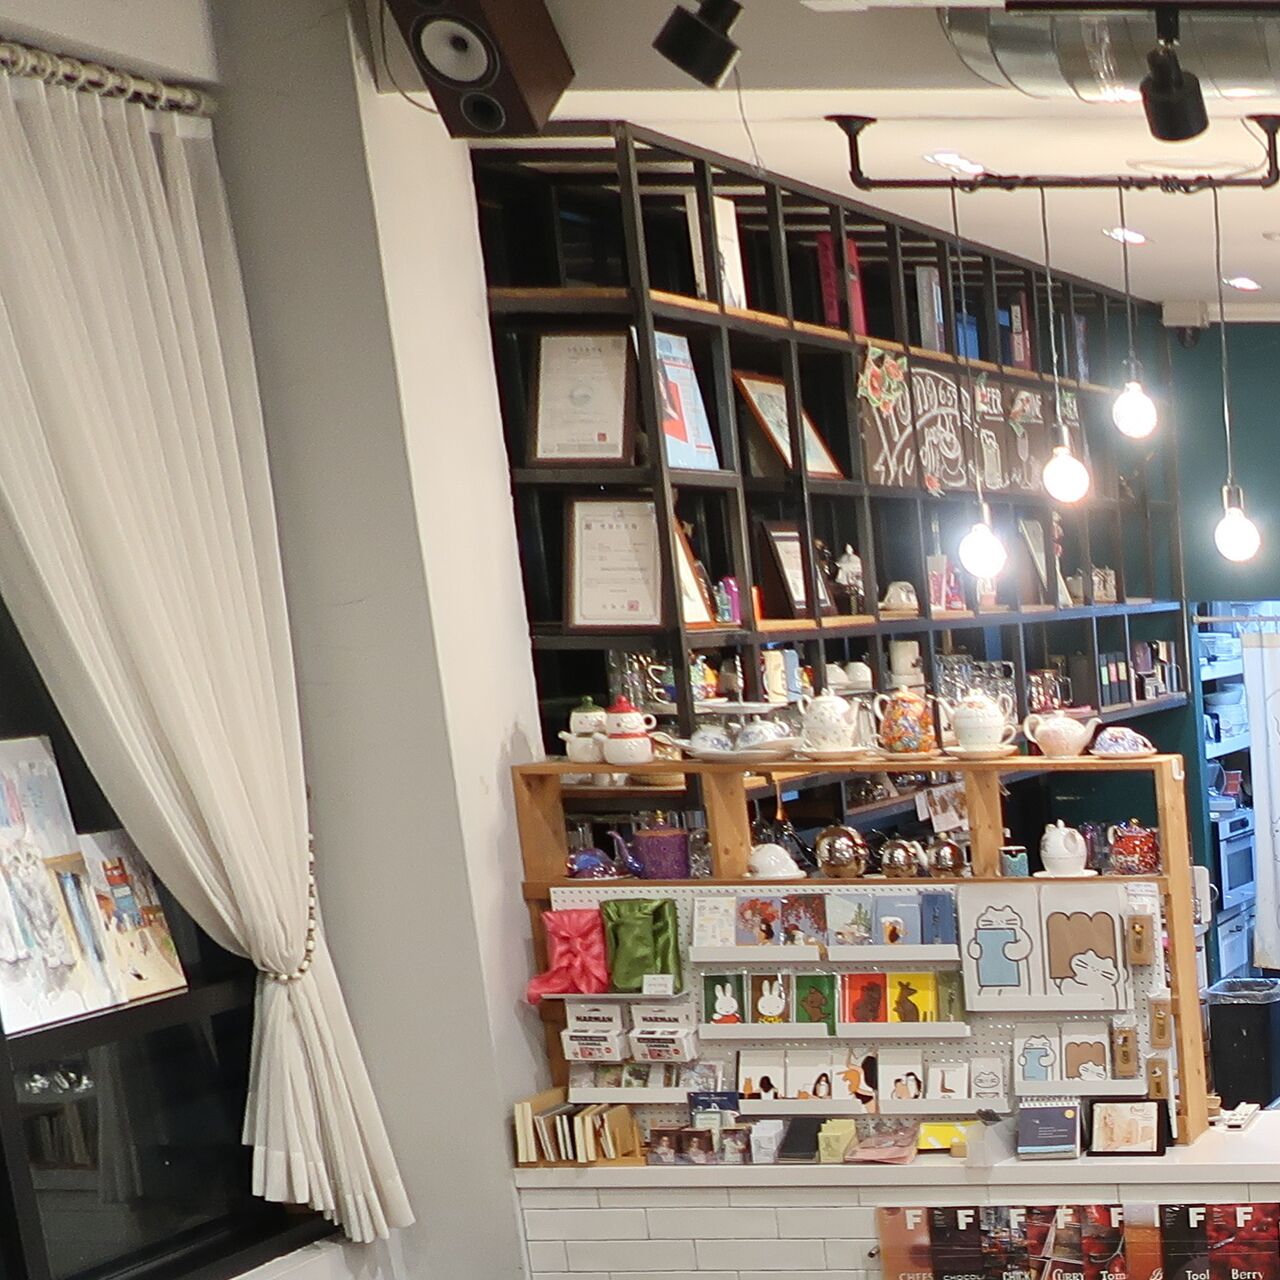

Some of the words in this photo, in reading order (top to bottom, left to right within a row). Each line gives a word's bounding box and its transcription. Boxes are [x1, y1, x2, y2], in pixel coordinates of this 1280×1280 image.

[905, 1209, 922, 1230] F
[956, 1209, 975, 1230] F
[1009, 1208, 1026, 1229] F
[1055, 1208, 1074, 1229] F
[1110, 1207, 1123, 1228] F
[1188, 1207, 1206, 1228] F
[1235, 1206, 1253, 1228] F
